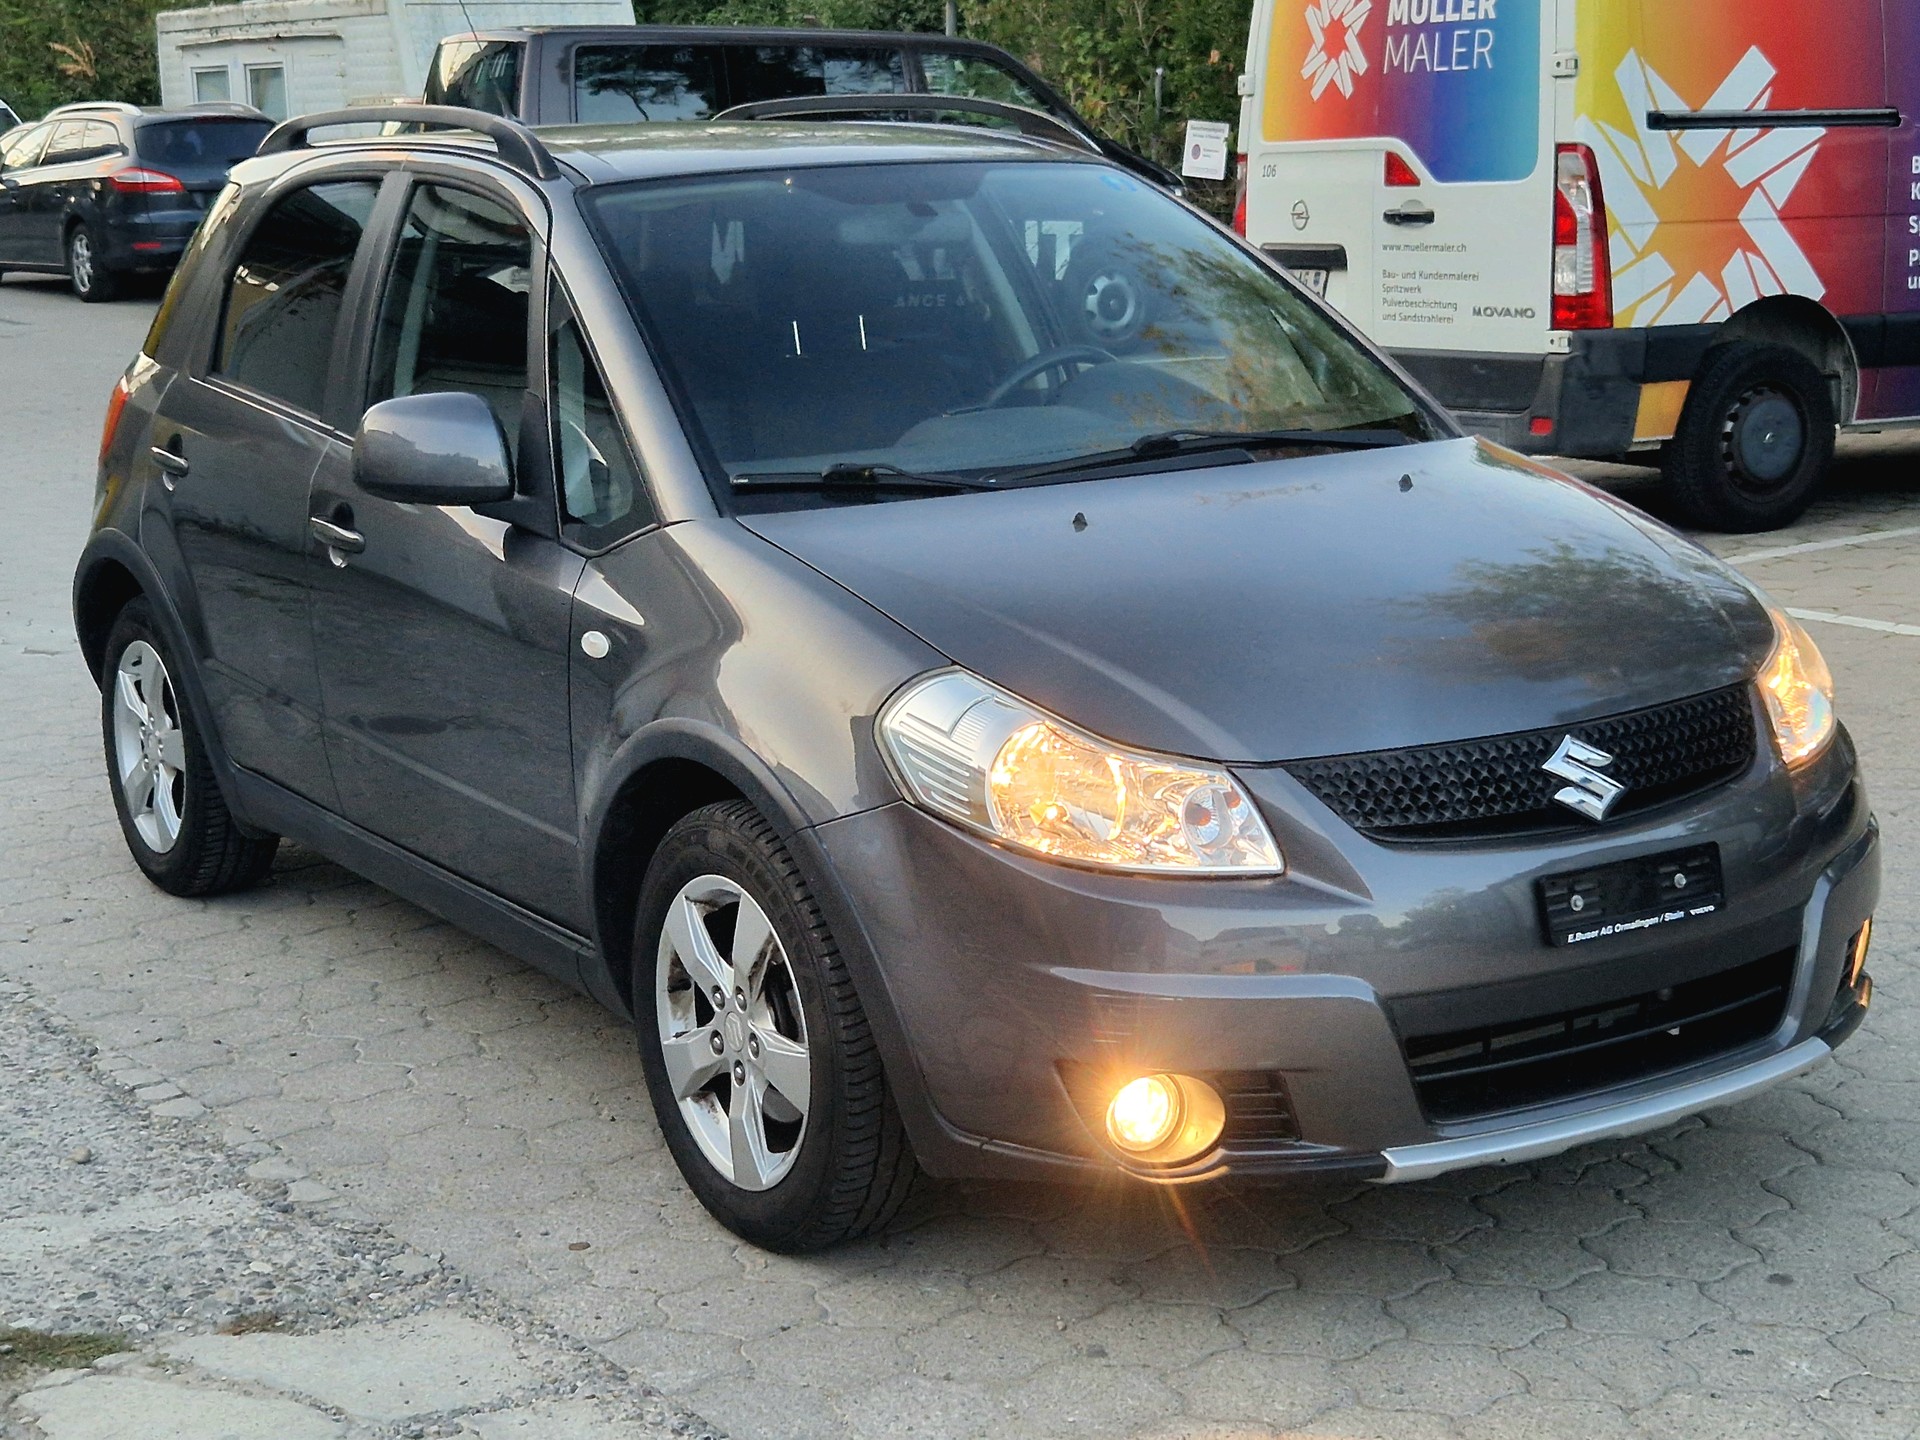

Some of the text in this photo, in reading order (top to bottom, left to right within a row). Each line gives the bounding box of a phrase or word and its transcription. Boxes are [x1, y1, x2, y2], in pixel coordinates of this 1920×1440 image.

[1383, 29, 1493, 74] MALER
[1261, 164, 1277, 178] 106
[1382, 241, 1467, 252] www.muellermaler.ch
[1382, 269, 1480, 281] Bau- und Kundenmalerei
[1382, 283, 1422, 294] Spritzwerk
[1382, 297, 1458, 311] Pulverbeschichtung
[1382, 312, 1454, 324] und Sandstrahlerei
[1472, 305, 1536, 319] MOVANO
[1600, 925, 1613, 937] AG
